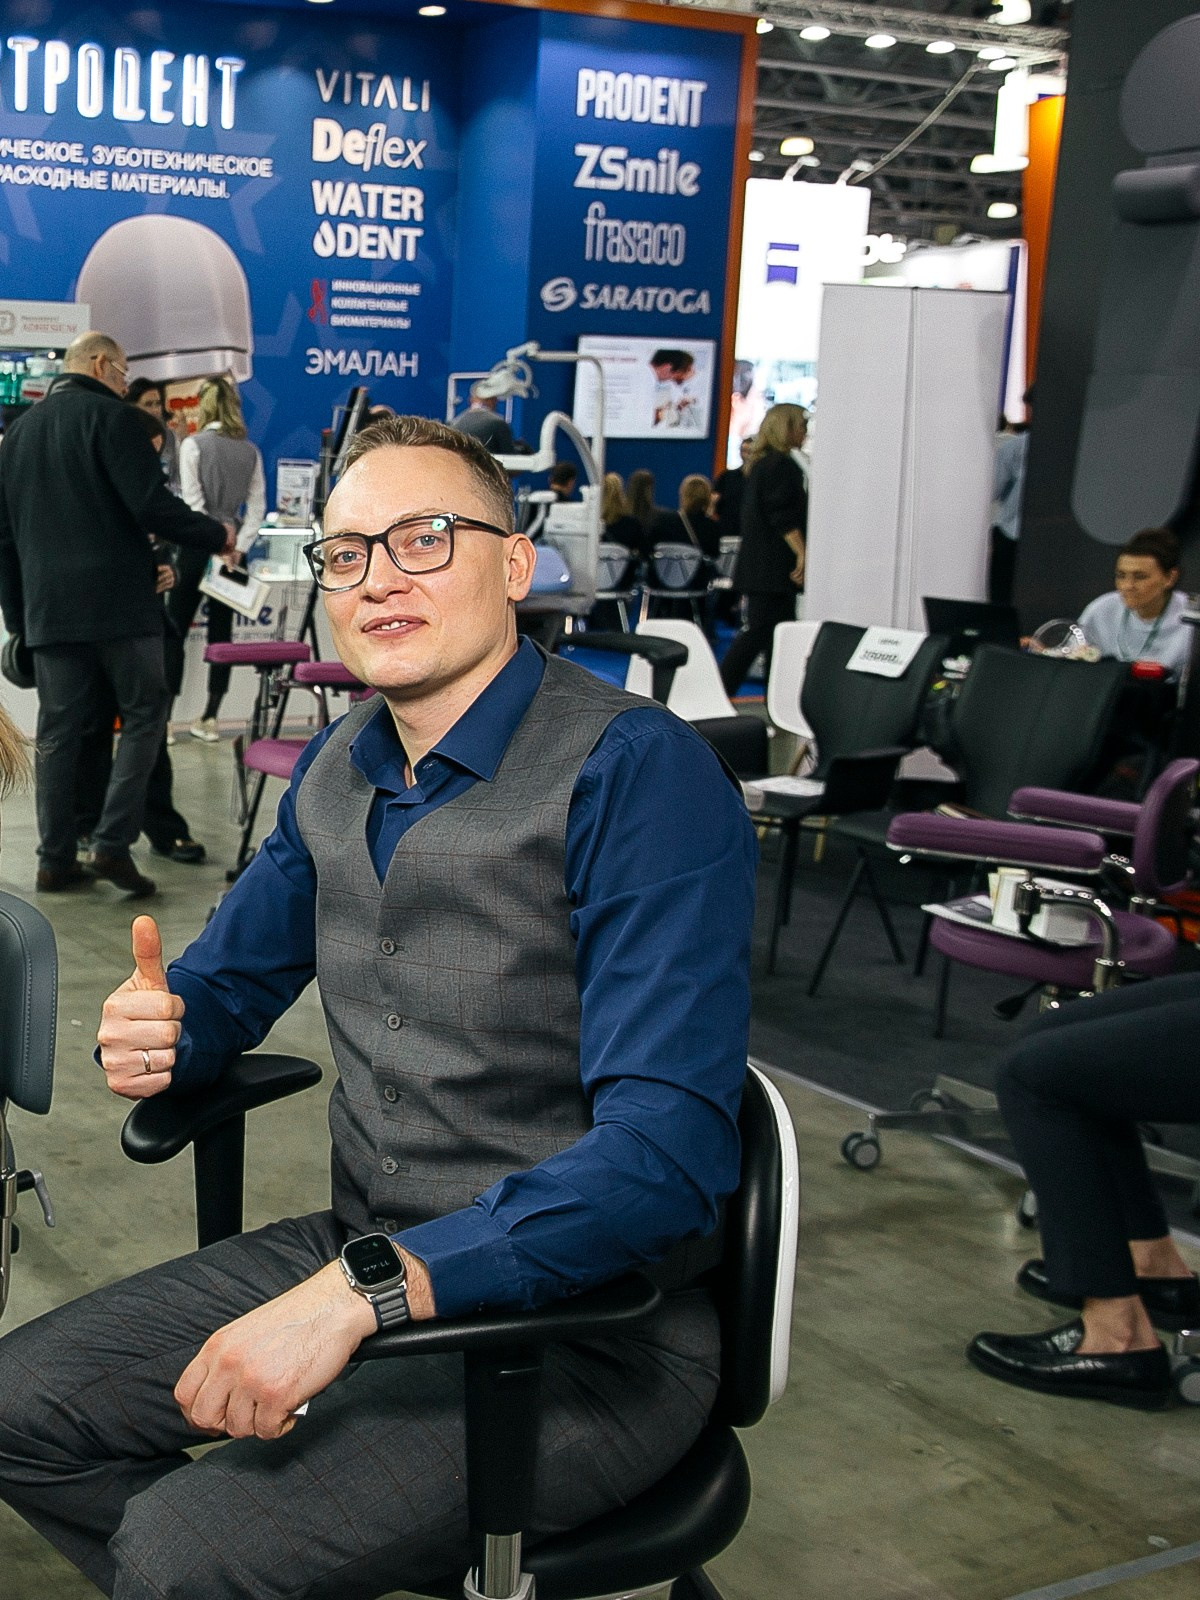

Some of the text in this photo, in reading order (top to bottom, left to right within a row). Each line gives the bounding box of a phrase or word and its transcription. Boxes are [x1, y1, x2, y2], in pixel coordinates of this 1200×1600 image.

[316, 68, 430, 112] VITALI
[576, 67, 708, 128] PRODENT
[92, 145, 273, 178] ЗУБОТЕХНИЧЕСКОЕ
[312, 117, 428, 172] Deflex
[111, 171, 231, 199] МАТЕРИАЛЫ.
[573, 143, 701, 197] ZSmile
[311, 179, 425, 222] WATER
[336, 222, 425, 262] DENT
[583, 201, 687, 267] frasaco
[578, 283, 711, 315] SARATOGA
[305, 347, 419, 377] ЭМАЛАН
